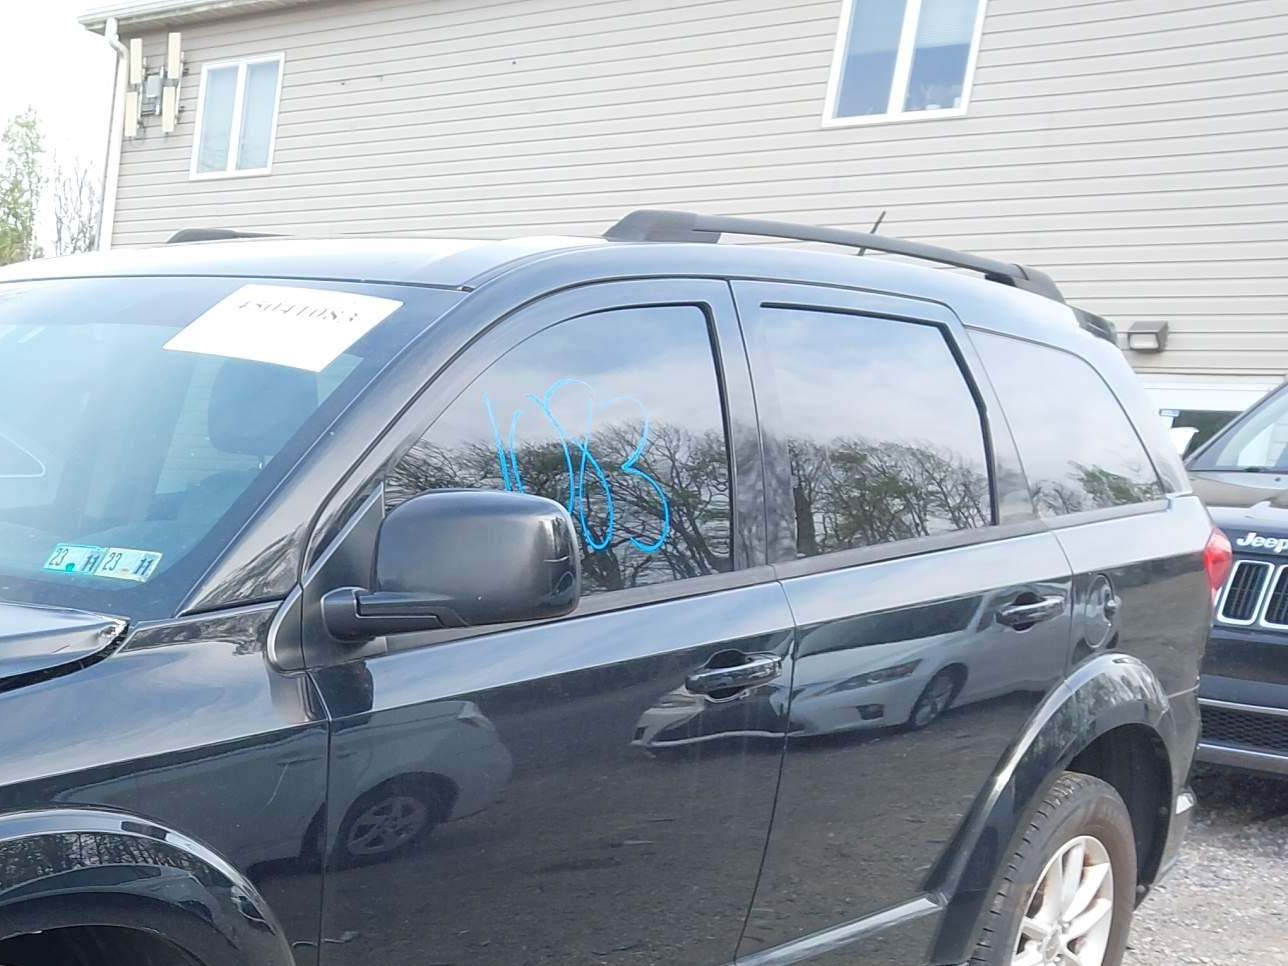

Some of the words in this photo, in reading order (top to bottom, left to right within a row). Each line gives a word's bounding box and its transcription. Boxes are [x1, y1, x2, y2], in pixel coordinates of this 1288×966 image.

[1236, 532, 1288, 553] Jeep
[48, 547, 70, 567] 23
[101, 551, 123, 572] 23
